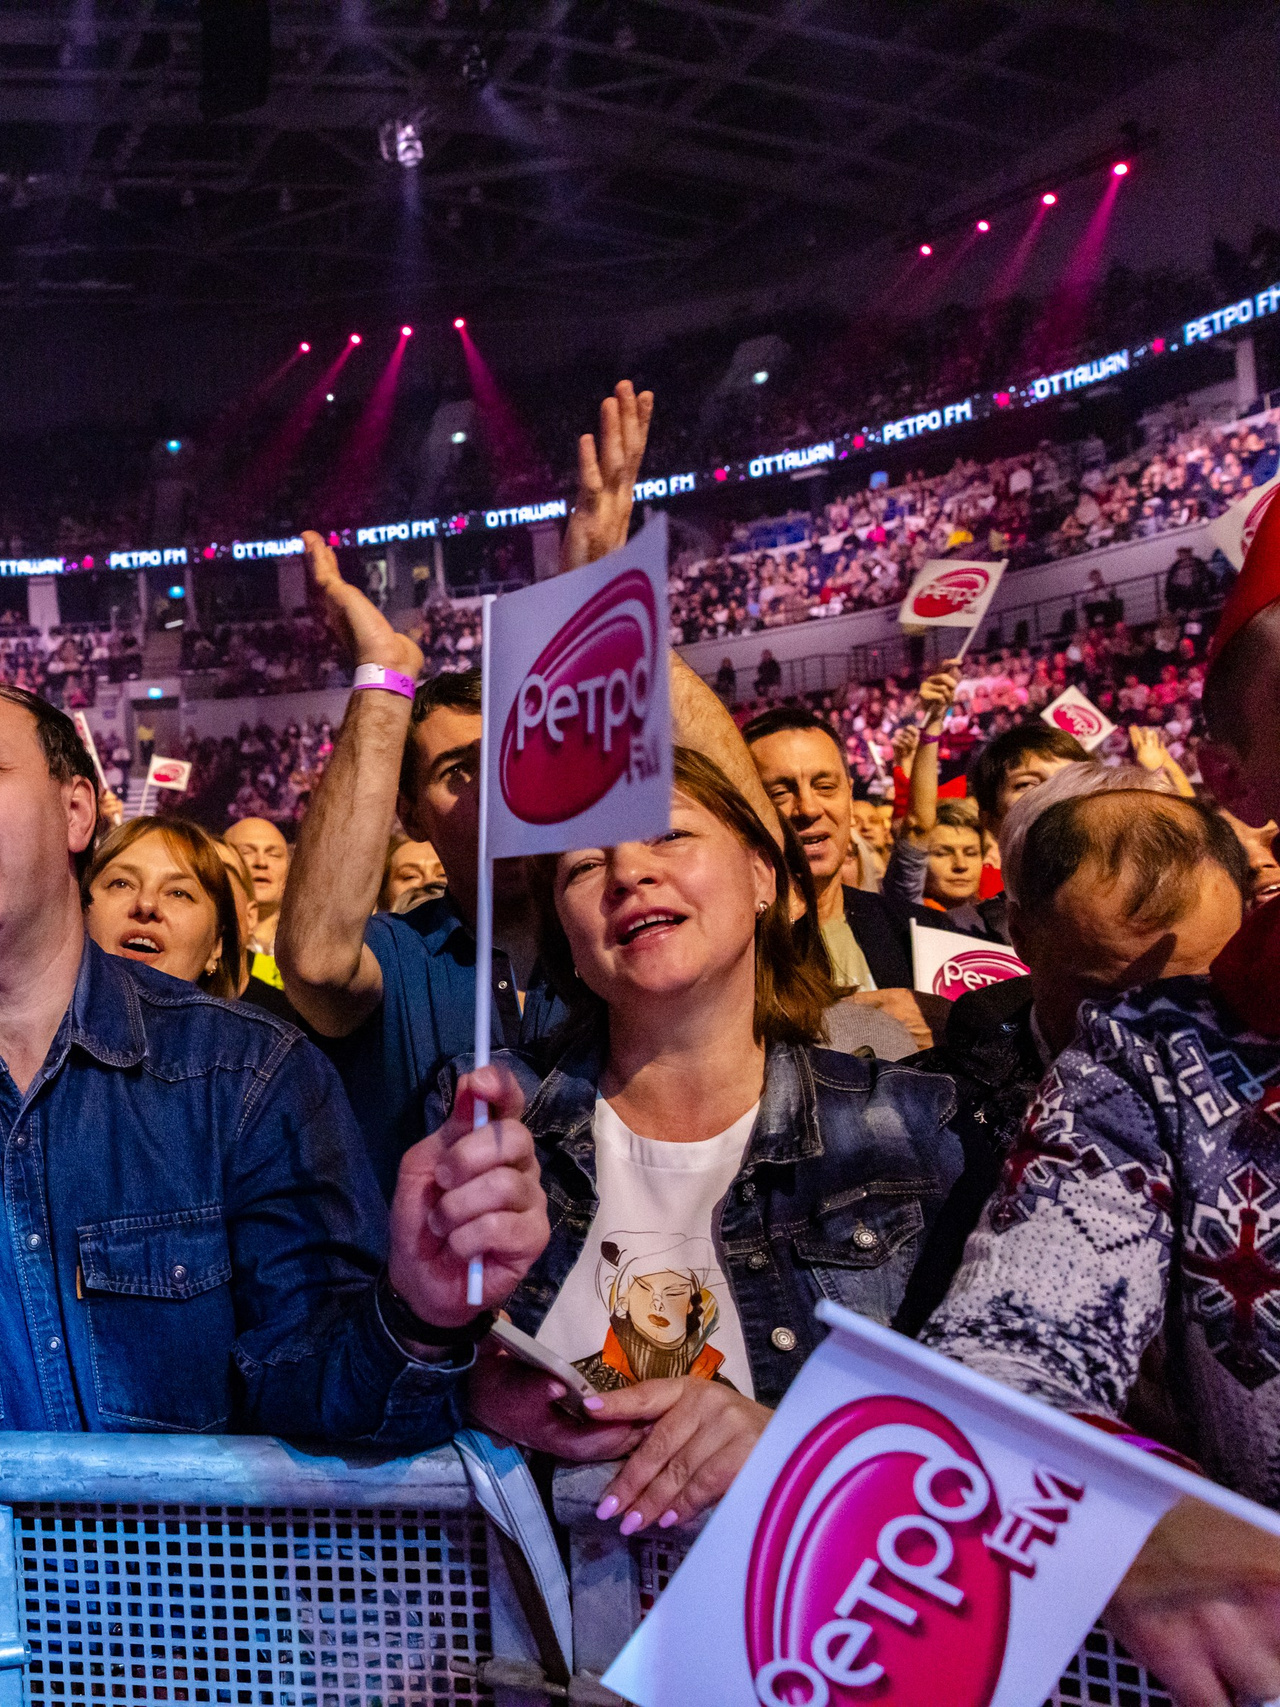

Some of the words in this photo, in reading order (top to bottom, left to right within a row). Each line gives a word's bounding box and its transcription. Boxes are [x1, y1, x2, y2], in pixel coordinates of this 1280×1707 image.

[1184, 299, 1253, 345] РЕТРО
[1032, 349, 1128, 399] OTTAWAN
[883, 410, 941, 444] РЕТРО
[944, 400, 972, 426] FM
[749, 441, 835, 477] OTTAWAN
[632, 478, 667, 501] ТРО
[669, 473, 695, 496] FM
[486, 500, 566, 528] OTTAWAN
[357, 523, 410, 545] РЕТРО
[411, 518, 436, 538] FM
[110, 550, 162, 569] РЕТРО
[163, 548, 187, 566] FM
[233, 538, 304, 559] OTTAWA
[943, 961, 1004, 991] Рет
[982, 1465, 1085, 1578] FM
